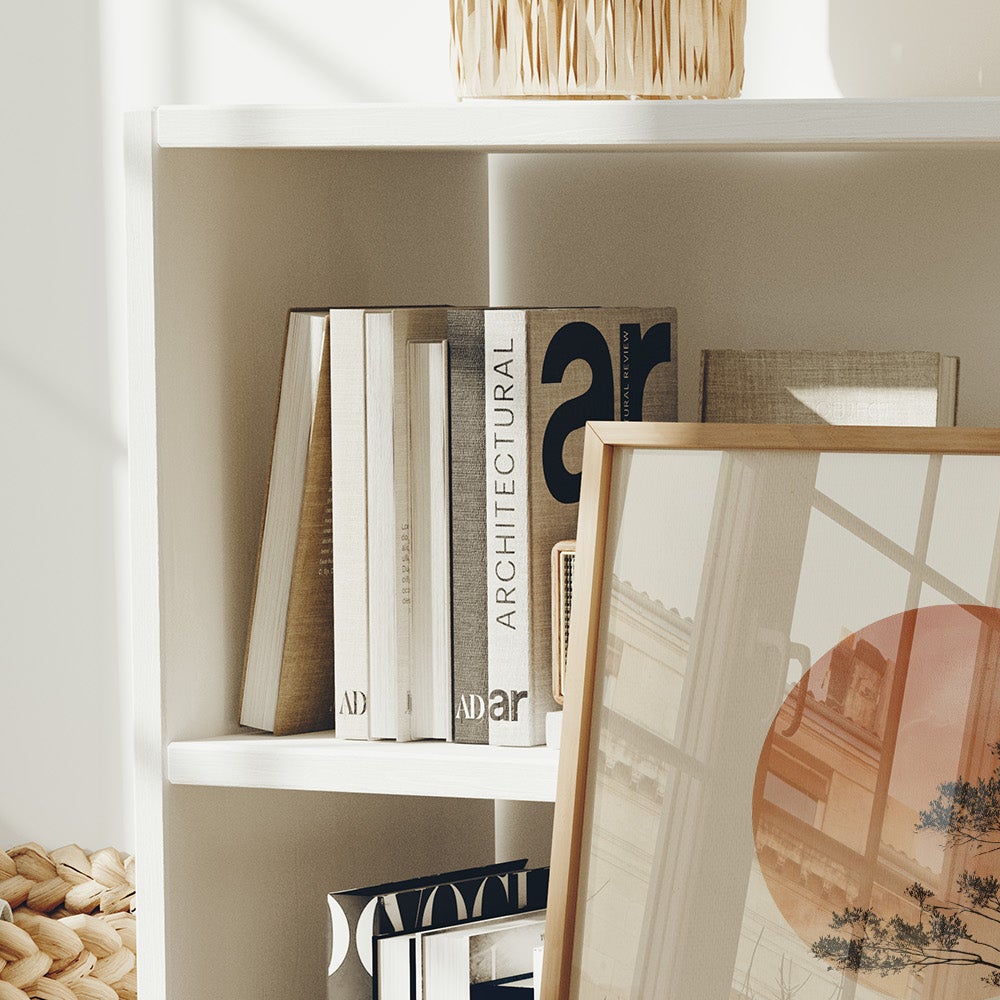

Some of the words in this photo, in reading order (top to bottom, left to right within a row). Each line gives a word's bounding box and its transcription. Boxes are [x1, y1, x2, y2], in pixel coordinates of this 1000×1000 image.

[541, 321, 671, 504] ar
[493, 338, 516, 630] ARCHITECTURAL
[339, 690, 368, 715] AD
[455, 694, 485, 719] AD
[489, 689, 528, 721] ar
